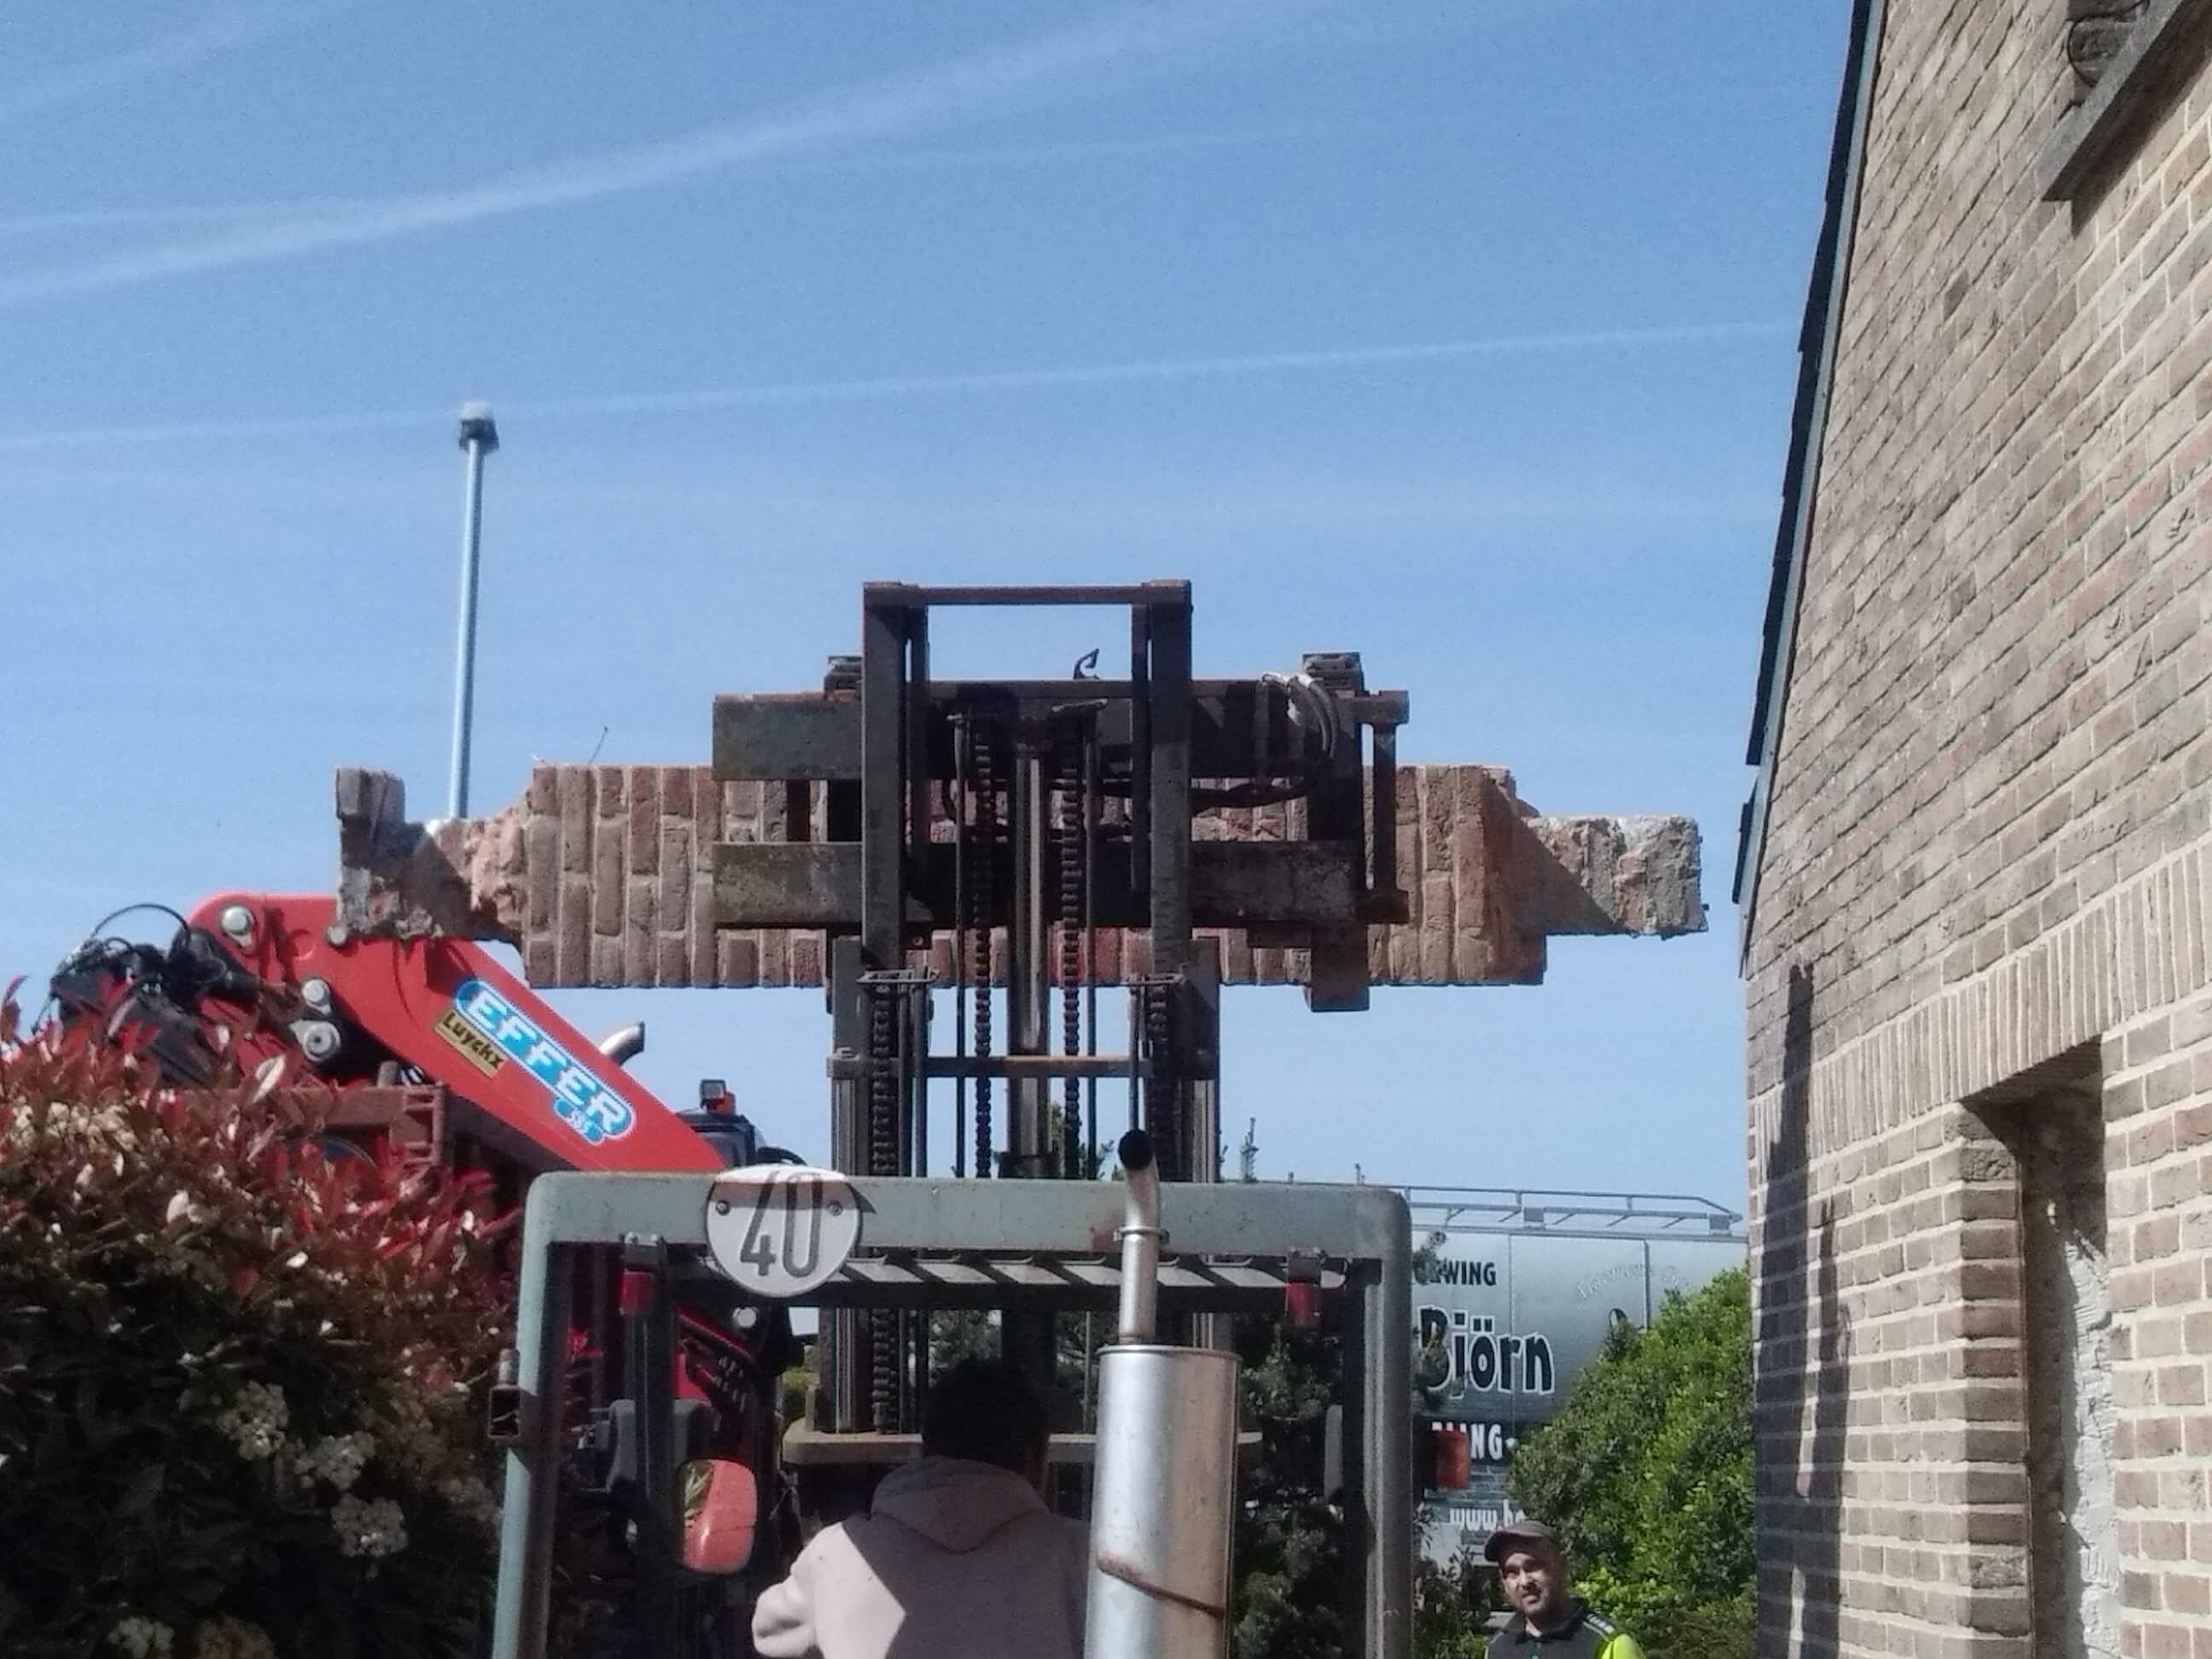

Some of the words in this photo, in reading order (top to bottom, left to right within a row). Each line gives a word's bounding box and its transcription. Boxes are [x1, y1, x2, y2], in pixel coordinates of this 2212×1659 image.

[468, 989, 628, 1133] EFFER
[740, 1170, 823, 1278] 40
[1418, 1305, 1555, 1400] Björn
